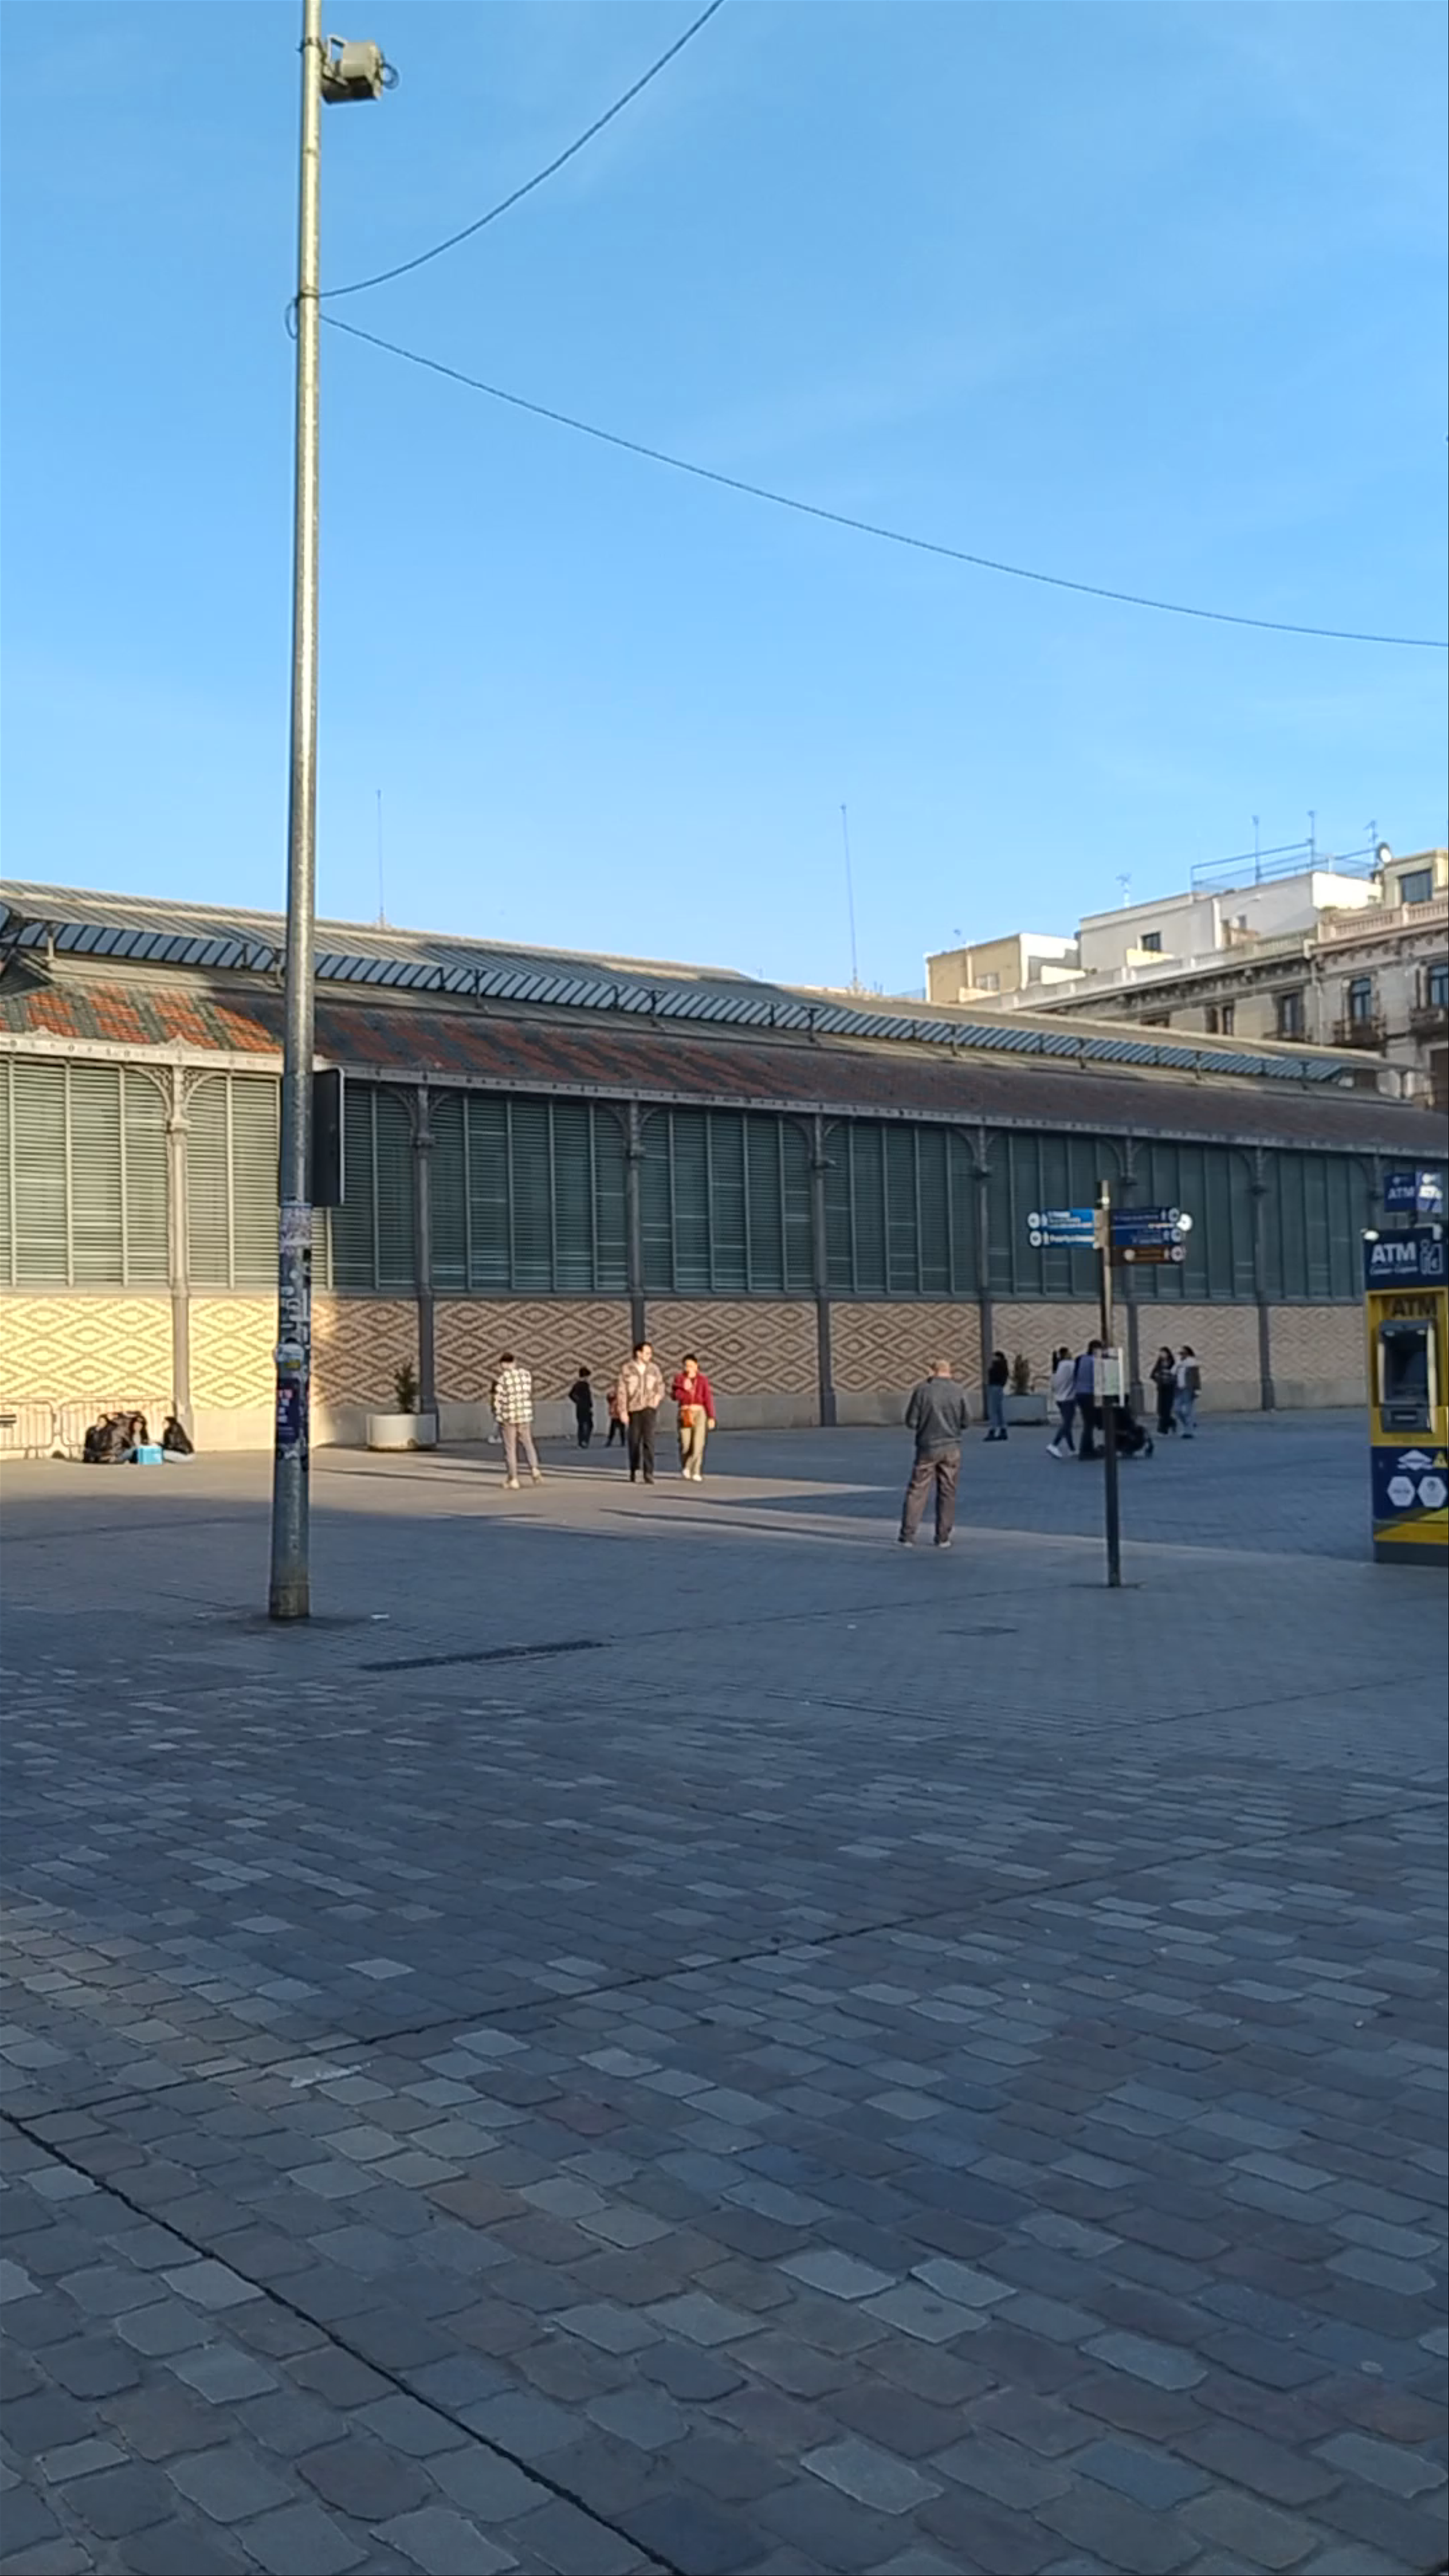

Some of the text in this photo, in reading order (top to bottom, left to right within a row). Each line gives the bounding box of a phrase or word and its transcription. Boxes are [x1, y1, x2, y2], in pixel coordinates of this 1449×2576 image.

[1388, 1186, 1414, 1200] ATM
[1371, 1242, 1415, 1263] ATM
[1391, 1296, 1437, 1317] ATM
